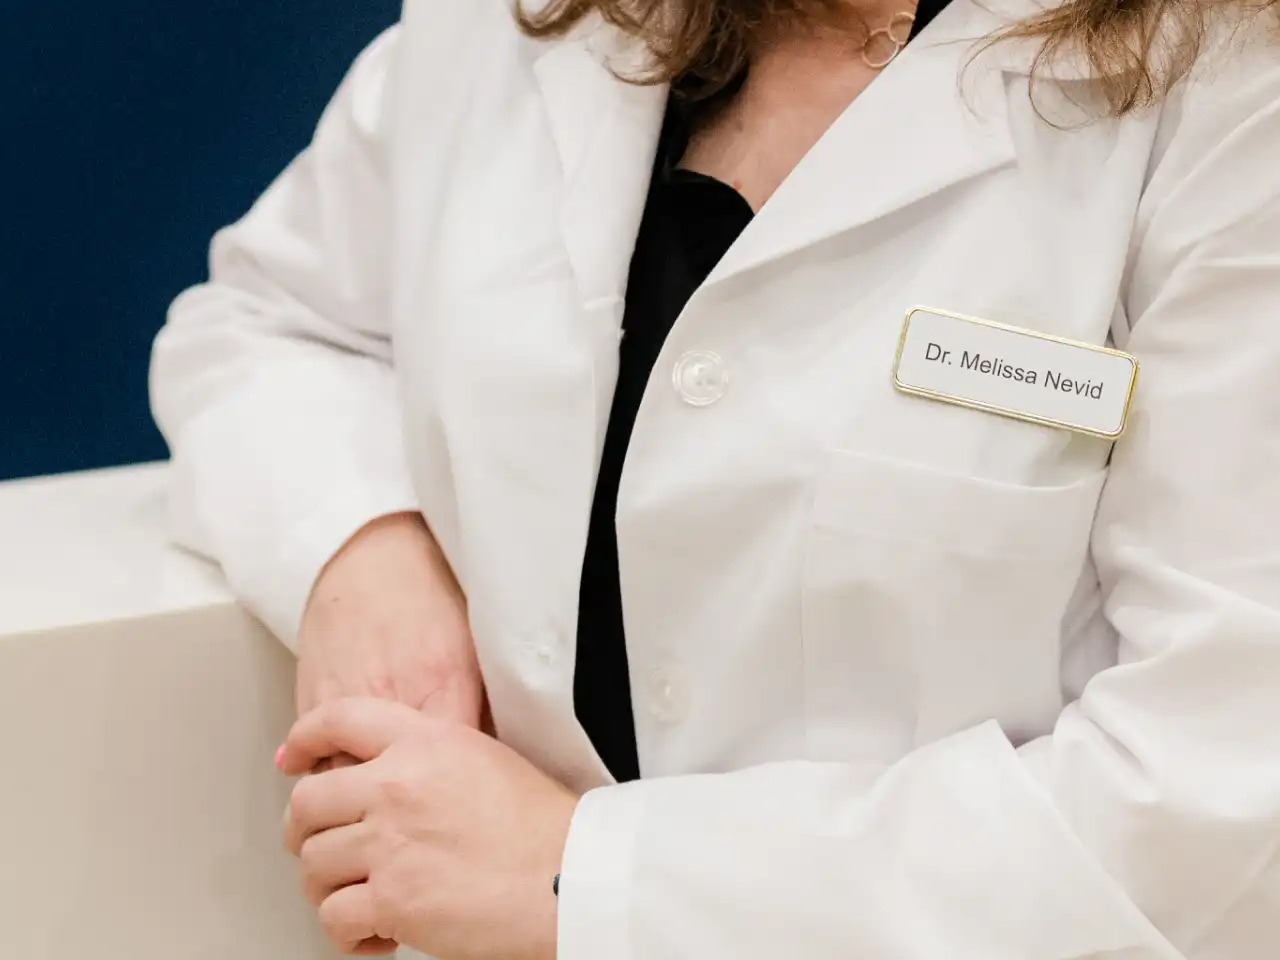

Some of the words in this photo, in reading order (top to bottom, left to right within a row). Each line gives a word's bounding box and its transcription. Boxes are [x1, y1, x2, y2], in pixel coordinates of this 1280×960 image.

[924, 342, 952, 366] Dr.
[959, 350, 1038, 385] Melissa
[1043, 370, 1104, 400] Nevid
